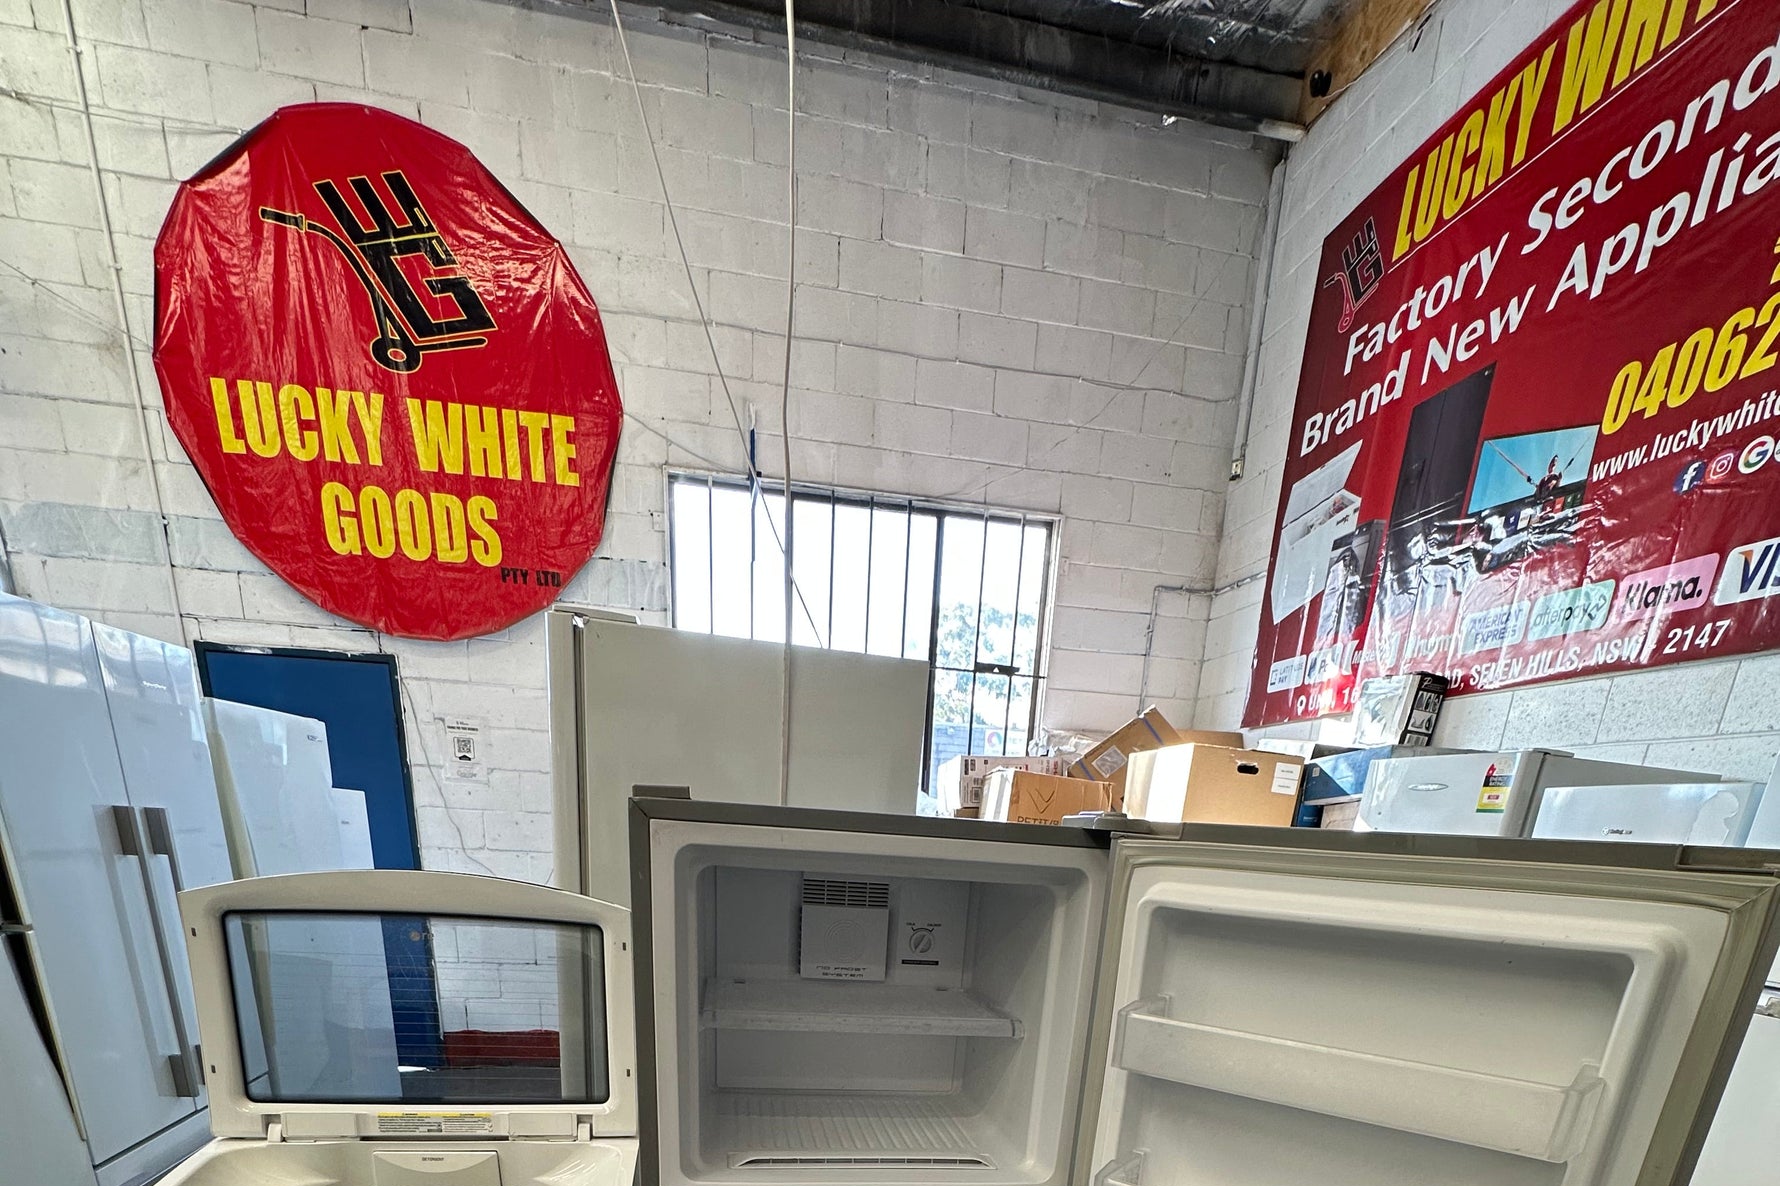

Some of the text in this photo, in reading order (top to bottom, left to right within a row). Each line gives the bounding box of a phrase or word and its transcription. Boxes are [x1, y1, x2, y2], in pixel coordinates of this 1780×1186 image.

[1392, 39, 1559, 263] LUCKY
[1344, 232, 1509, 376] Factory
[1300, 350, 1411, 457] Brand
[1421, 284, 1536, 386] New
[1602, 290, 1780, 435] 04062
[210, 377, 580, 487] LUCKY WHITE
[321, 482, 502, 567] GOODS
[501, 567, 529, 586] PTY
[1739, 543, 1780, 594] VI
[1663, 619, 1732, 654] 2147
